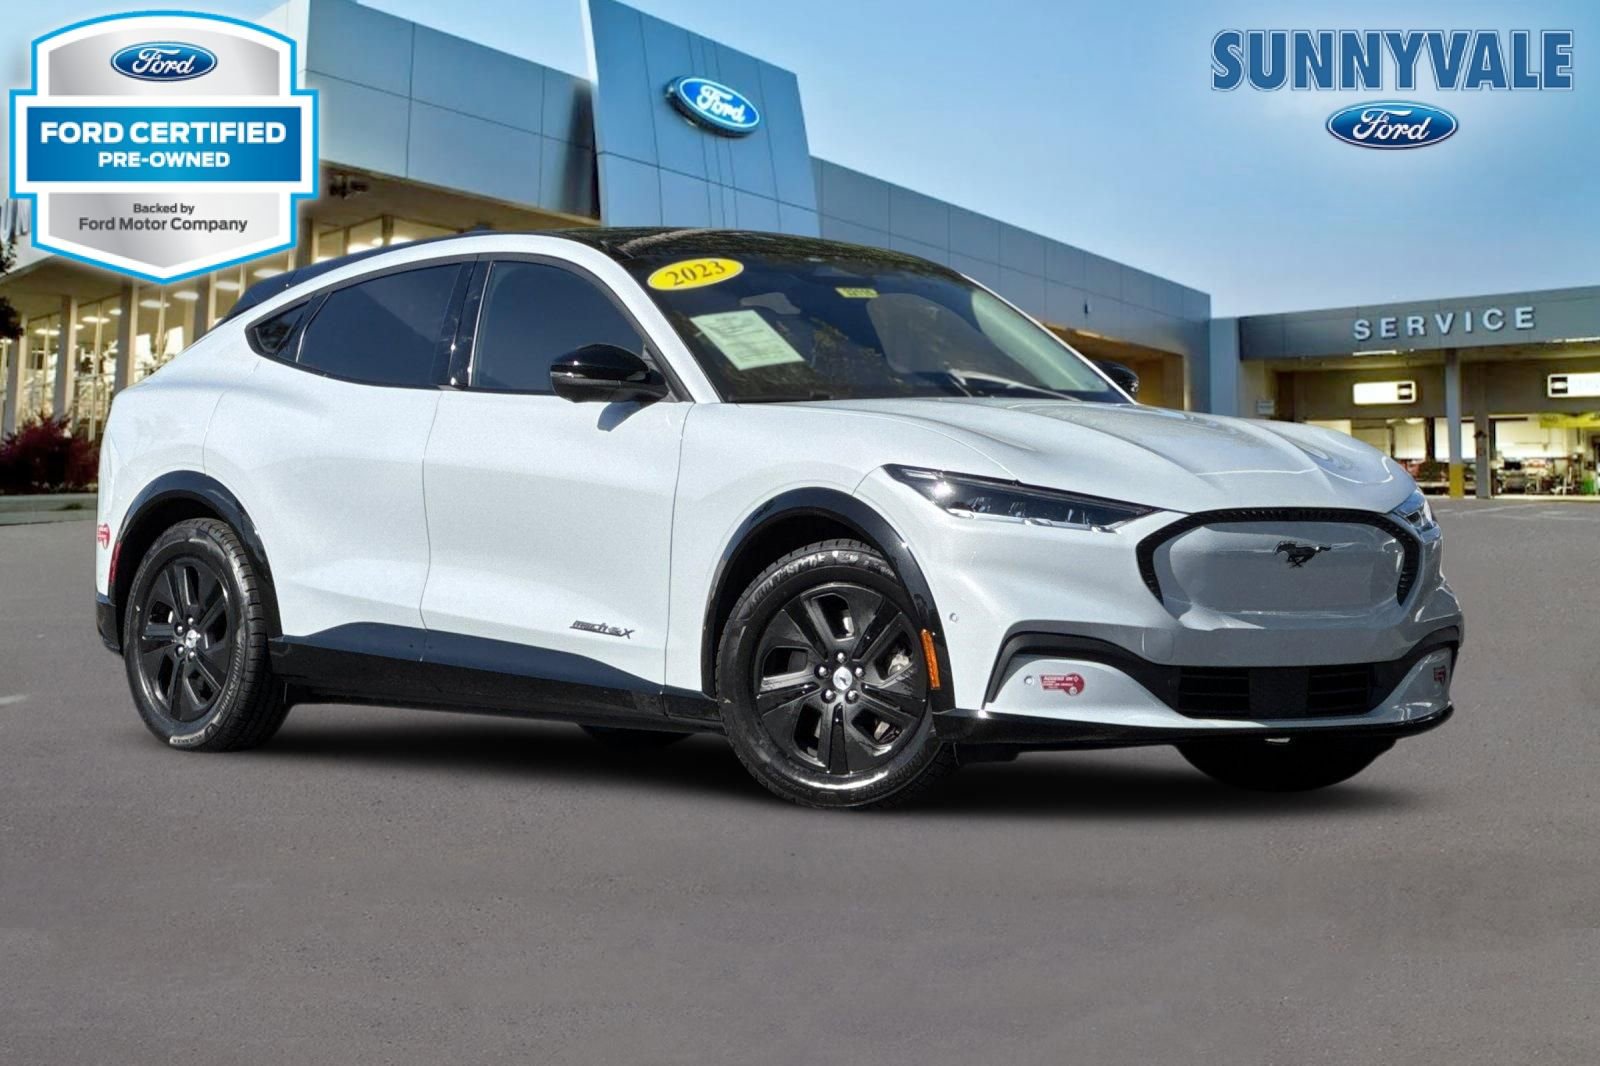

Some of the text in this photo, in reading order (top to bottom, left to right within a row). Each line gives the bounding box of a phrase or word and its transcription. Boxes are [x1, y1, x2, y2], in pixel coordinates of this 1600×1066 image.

[696, 85, 746, 122] Ford
[665, 260, 726, 286] 2023
[1353, 306, 1535, 340] SERVICE
